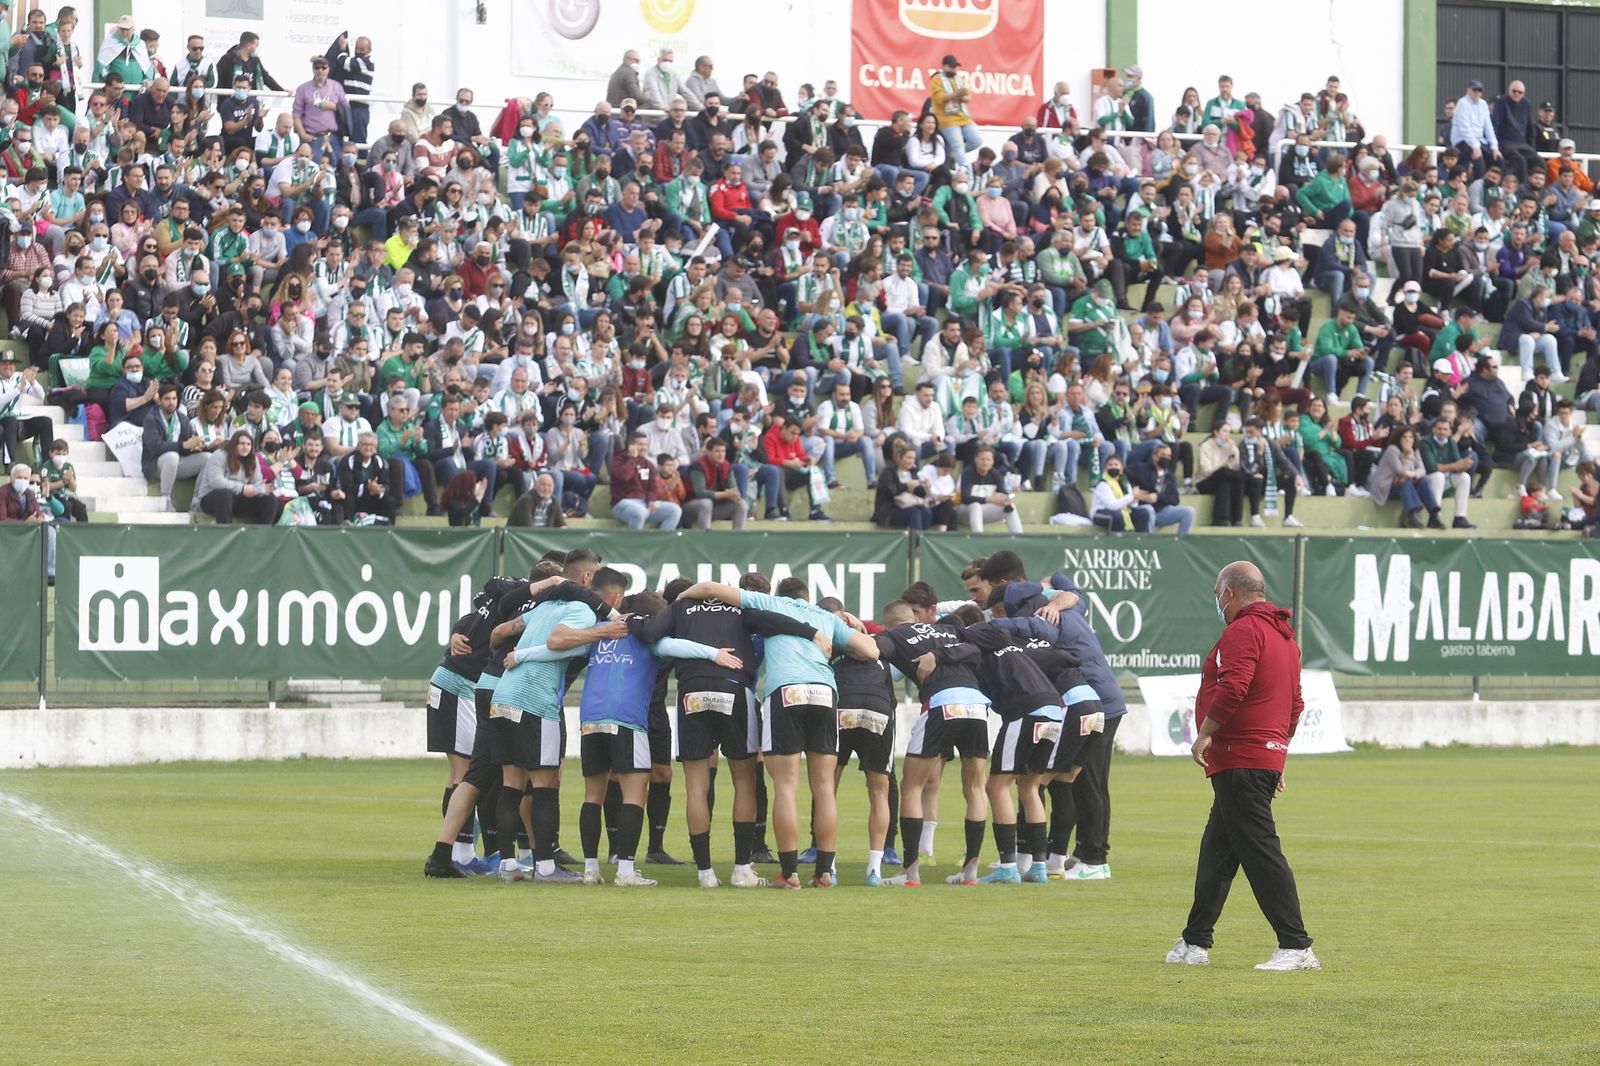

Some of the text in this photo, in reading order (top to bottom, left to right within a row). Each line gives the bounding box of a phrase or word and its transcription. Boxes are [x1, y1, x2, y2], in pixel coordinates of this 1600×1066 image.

[895, 66, 926, 90] LA
[1064, 548, 1162, 570] NARBONA
[1073, 569, 1152, 590] ONLINE
[1440, 643, 1475, 659] gastro
